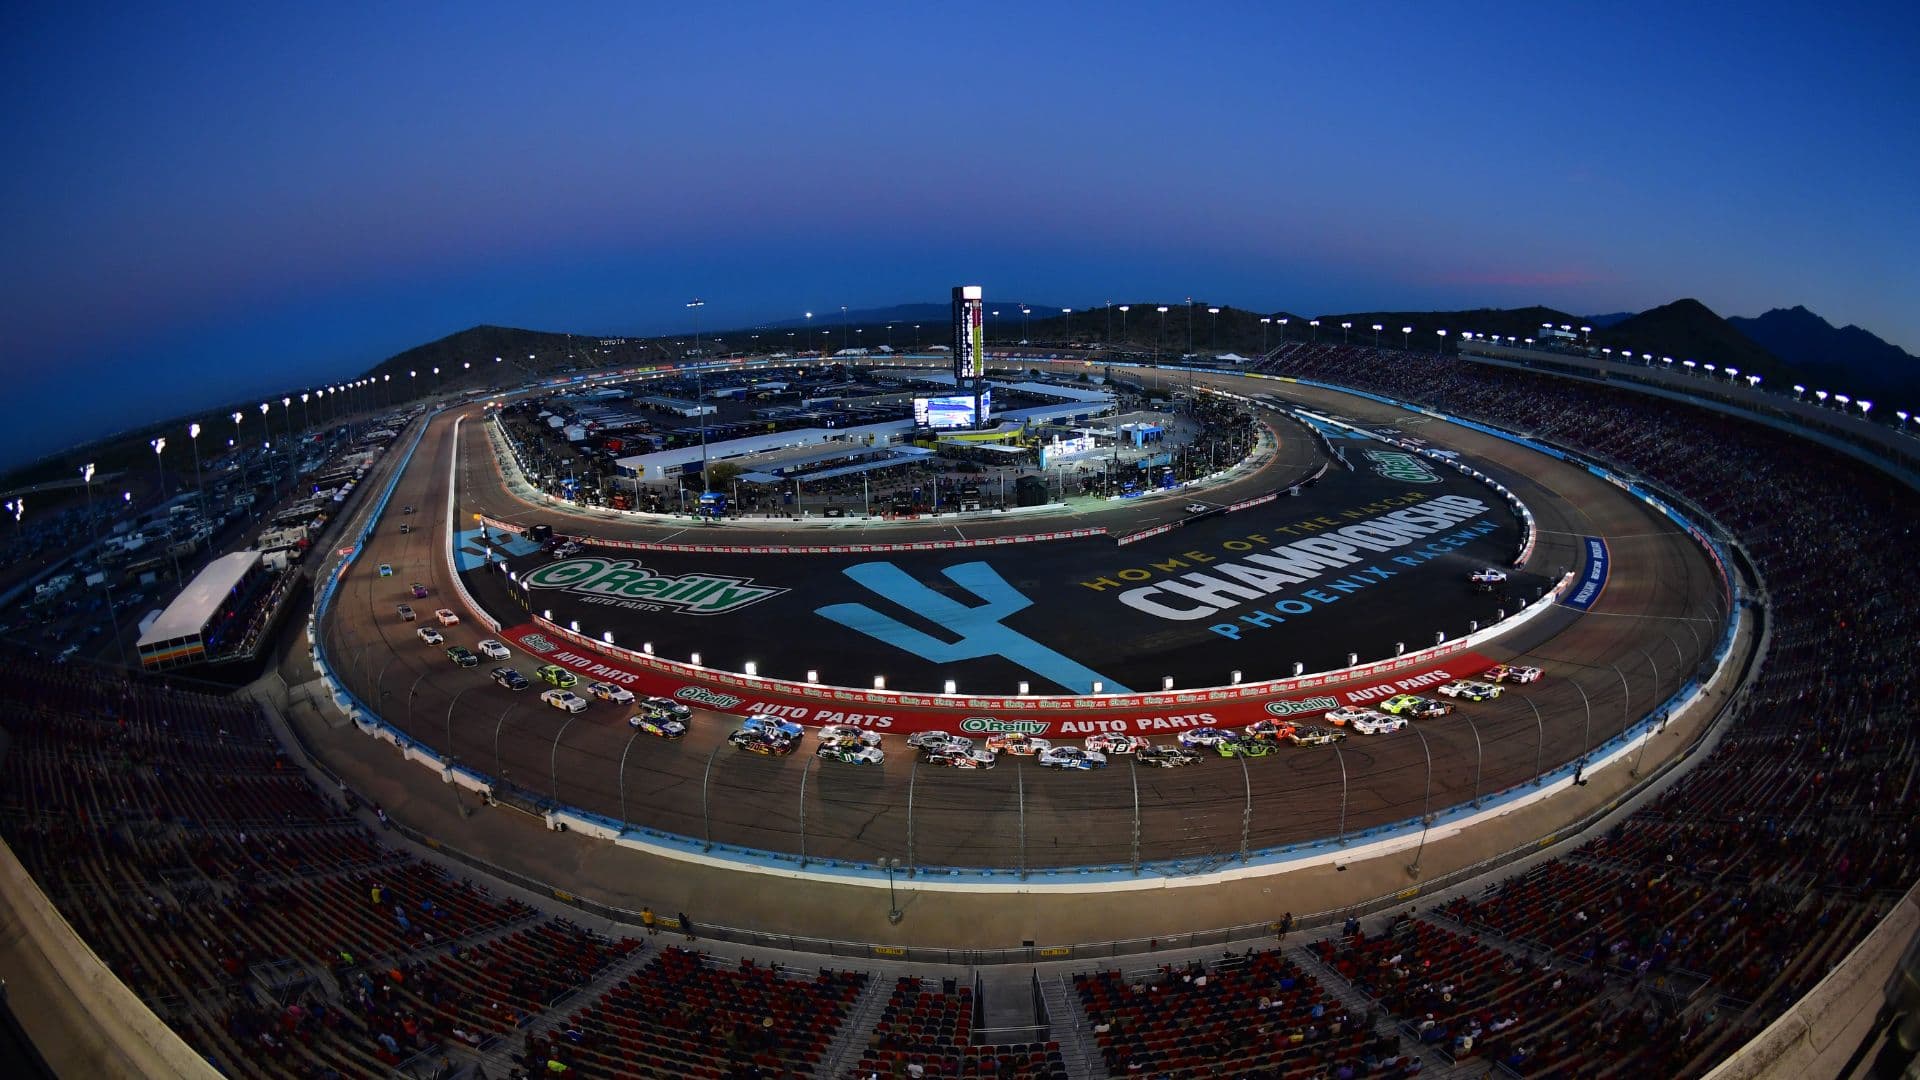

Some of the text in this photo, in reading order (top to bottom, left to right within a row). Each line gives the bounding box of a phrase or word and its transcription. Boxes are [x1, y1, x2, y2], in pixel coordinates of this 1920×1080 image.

[600, 338, 626, 346] TOYOTA
[1080, 491, 1430, 591] HOME OF THE NASCAR
[1118, 494, 1490, 621] CHAMPIONSHIP
[523, 557, 776, 613] O'Reilly
[1207, 519, 1502, 640] PHOENIX RACEWAY
[580, 596, 664, 612] AUTO PARTS
[552, 651, 588, 669] AUTO
[586, 664, 640, 685] PARTS
[675, 686, 744, 708] O'Reilly
[745, 702, 809, 719] AUTO
[814, 710, 894, 728] PARTS
[1265, 669, 1451, 716] O'Reilly AUTO PARTS
[960, 712, 1218, 734] O'Reilly AUTO PARTS
[954, 758, 967, 766] 39
